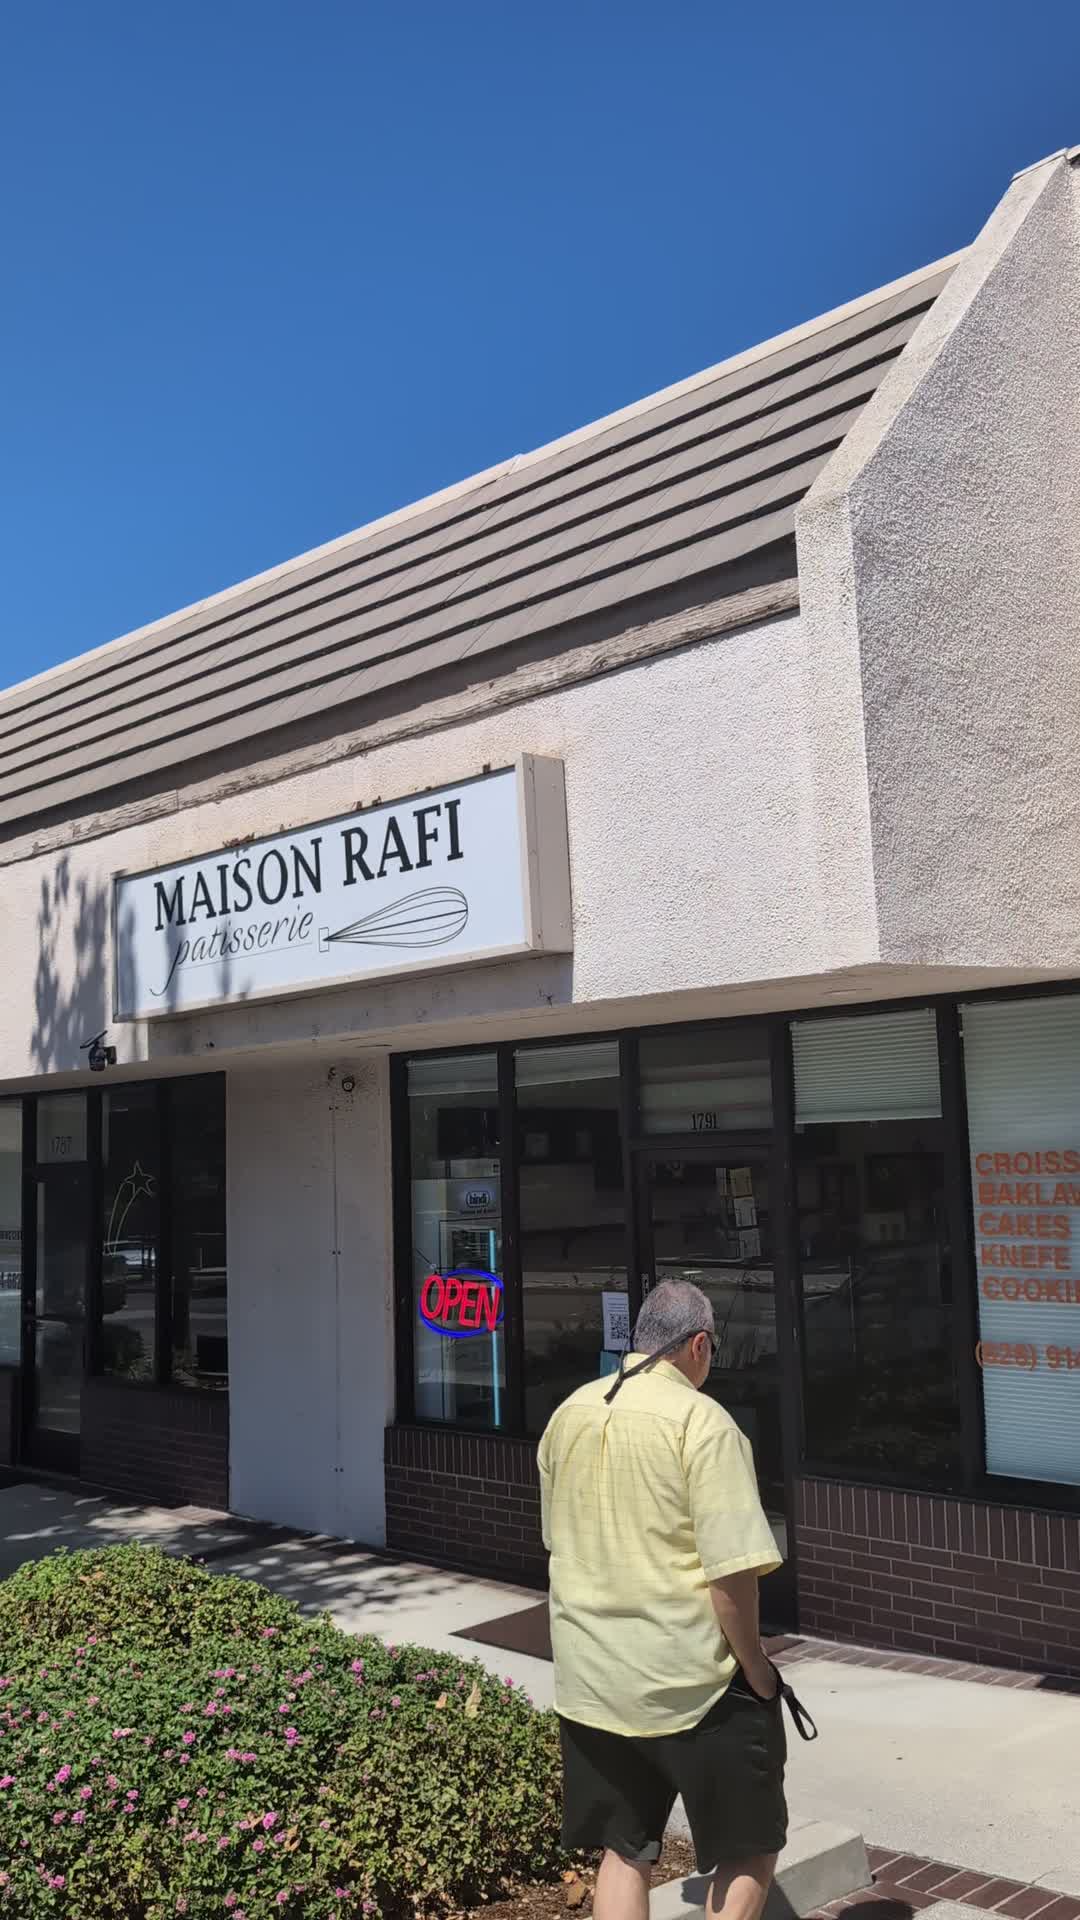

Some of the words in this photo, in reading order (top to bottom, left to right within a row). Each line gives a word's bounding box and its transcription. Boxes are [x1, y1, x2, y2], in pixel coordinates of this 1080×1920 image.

[154, 837, 323, 931] MAISON
[340, 799, 464, 885] RAFI
[149, 904, 314, 996] patisserie
[691, 1112, 718, 1129] 1791
[978, 1212, 1071, 1239] CAKES
[981, 1244, 1071, 1271] KNEFE
[421, 1273, 500, 1332] OPEN
